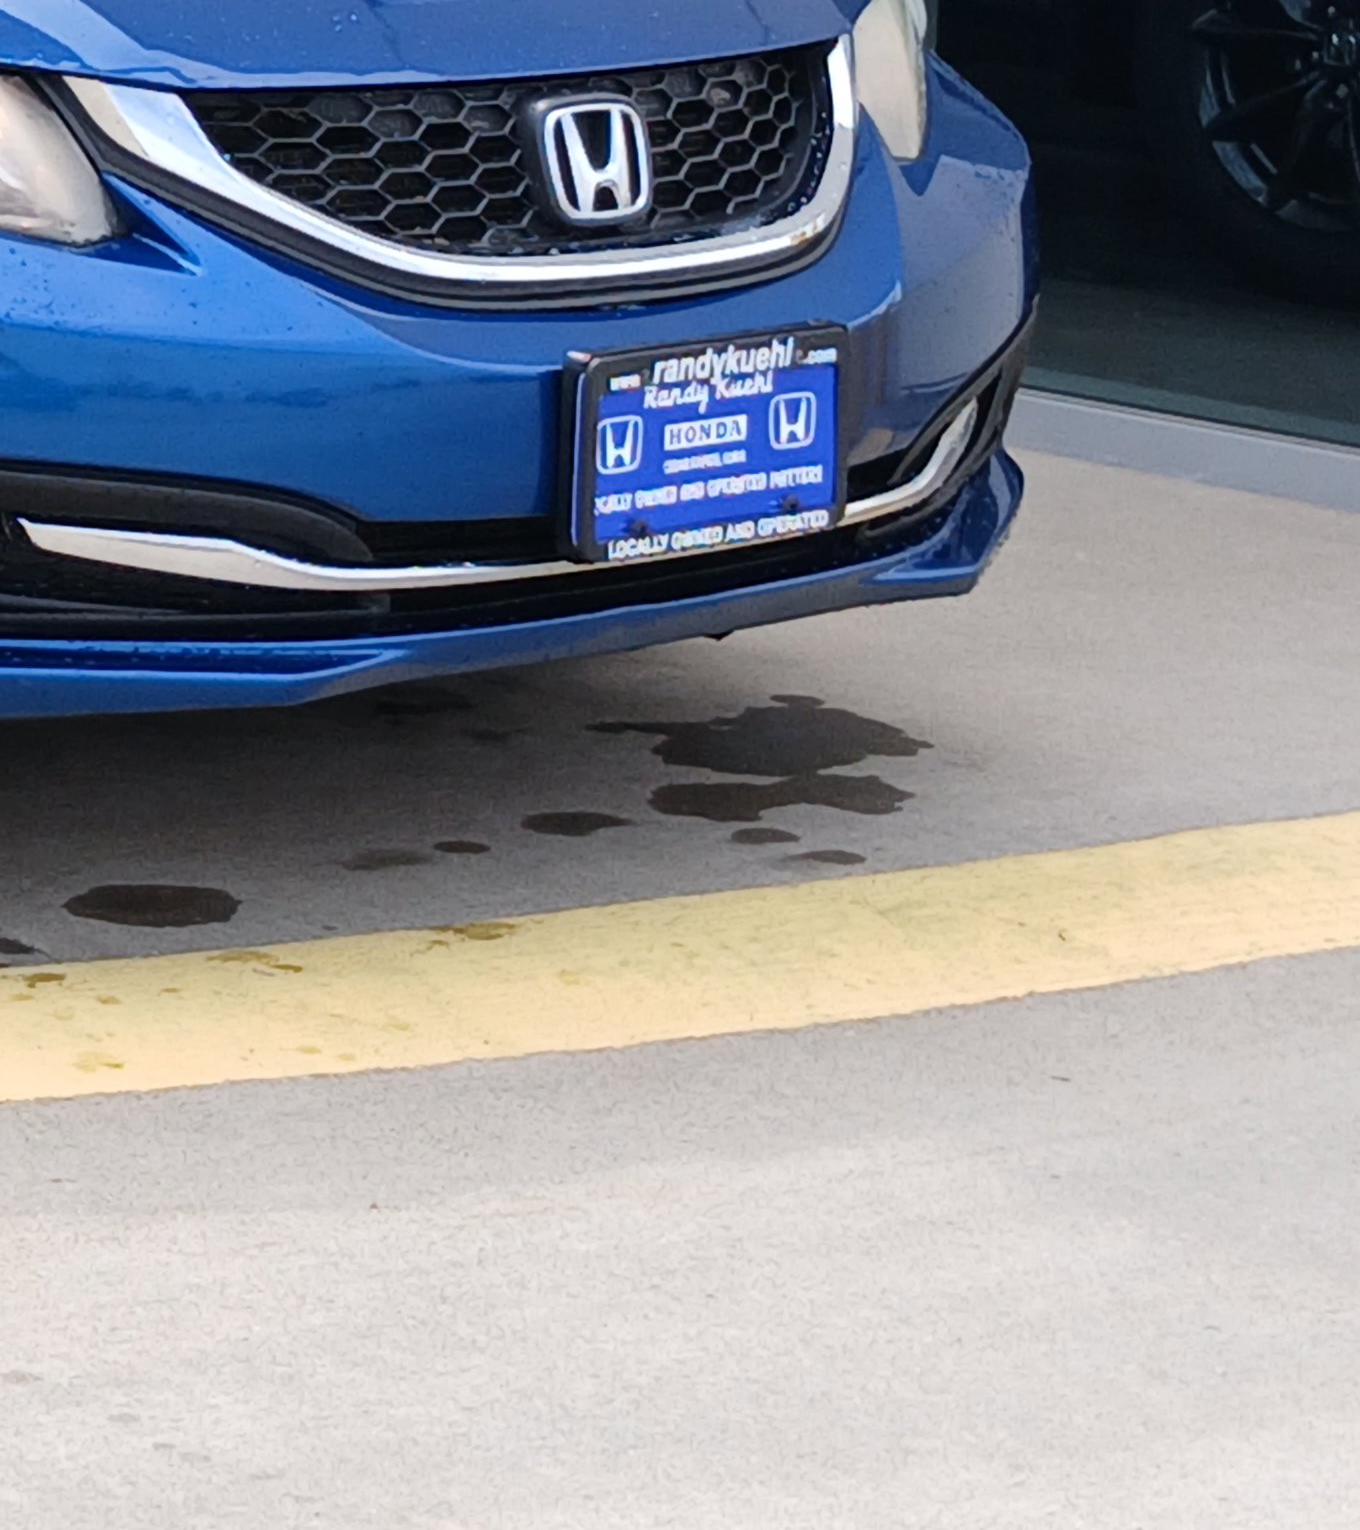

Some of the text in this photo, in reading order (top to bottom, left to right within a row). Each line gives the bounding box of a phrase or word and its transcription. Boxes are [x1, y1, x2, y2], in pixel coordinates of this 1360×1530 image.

[653, 337, 794, 384] randykuehl
[643, 370, 773, 414] Randy Kuehl
[669, 419, 743, 445] HONDA
[608, 509, 829, 560] LOCALLY OWNED AND OPERATED
